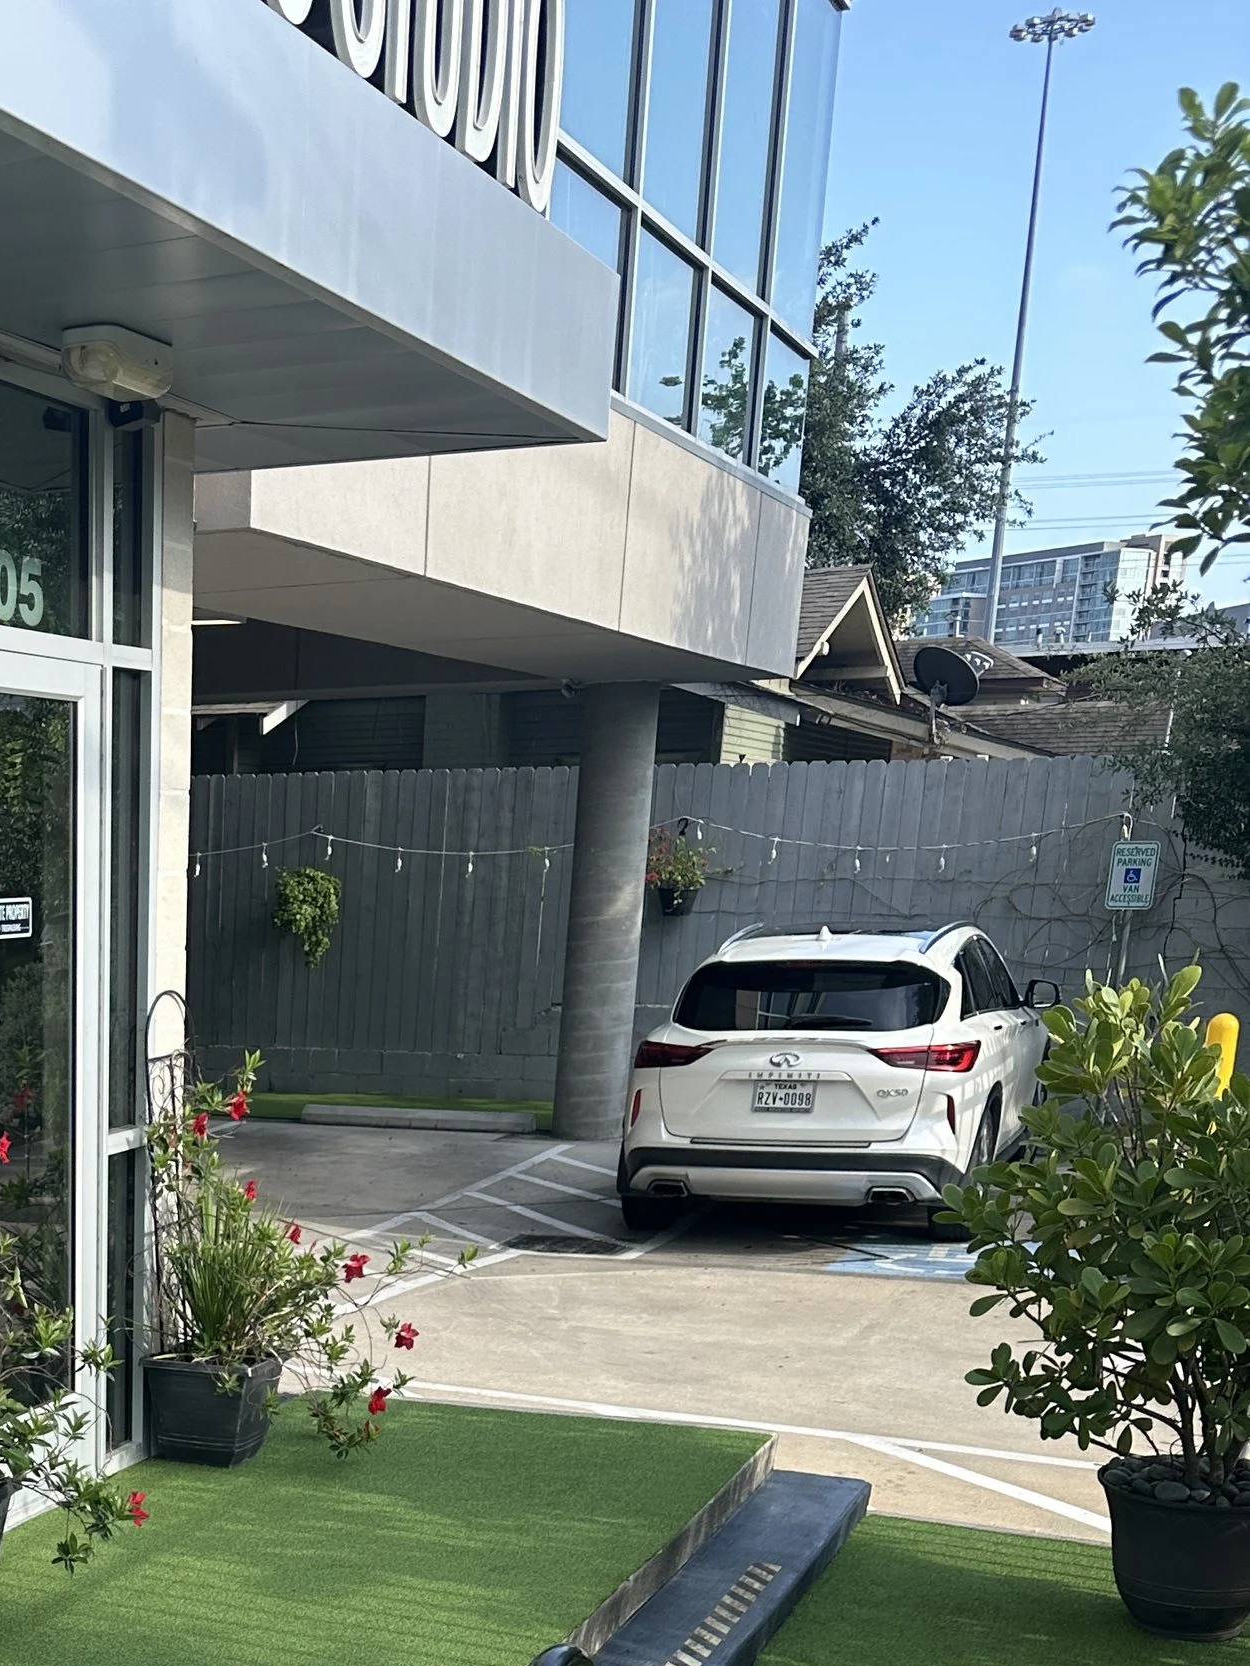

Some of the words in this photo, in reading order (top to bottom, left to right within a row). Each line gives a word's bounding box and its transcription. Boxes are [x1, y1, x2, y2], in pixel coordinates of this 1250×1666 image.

[1116, 848, 1155, 857] RESERVED
[1117, 858, 1152, 867] PARKING
[1123, 885, 1140, 893] VAN
[1110, 894, 1149, 903] ACCESSIBLE
[877, 1089, 908, 1098] QX50
